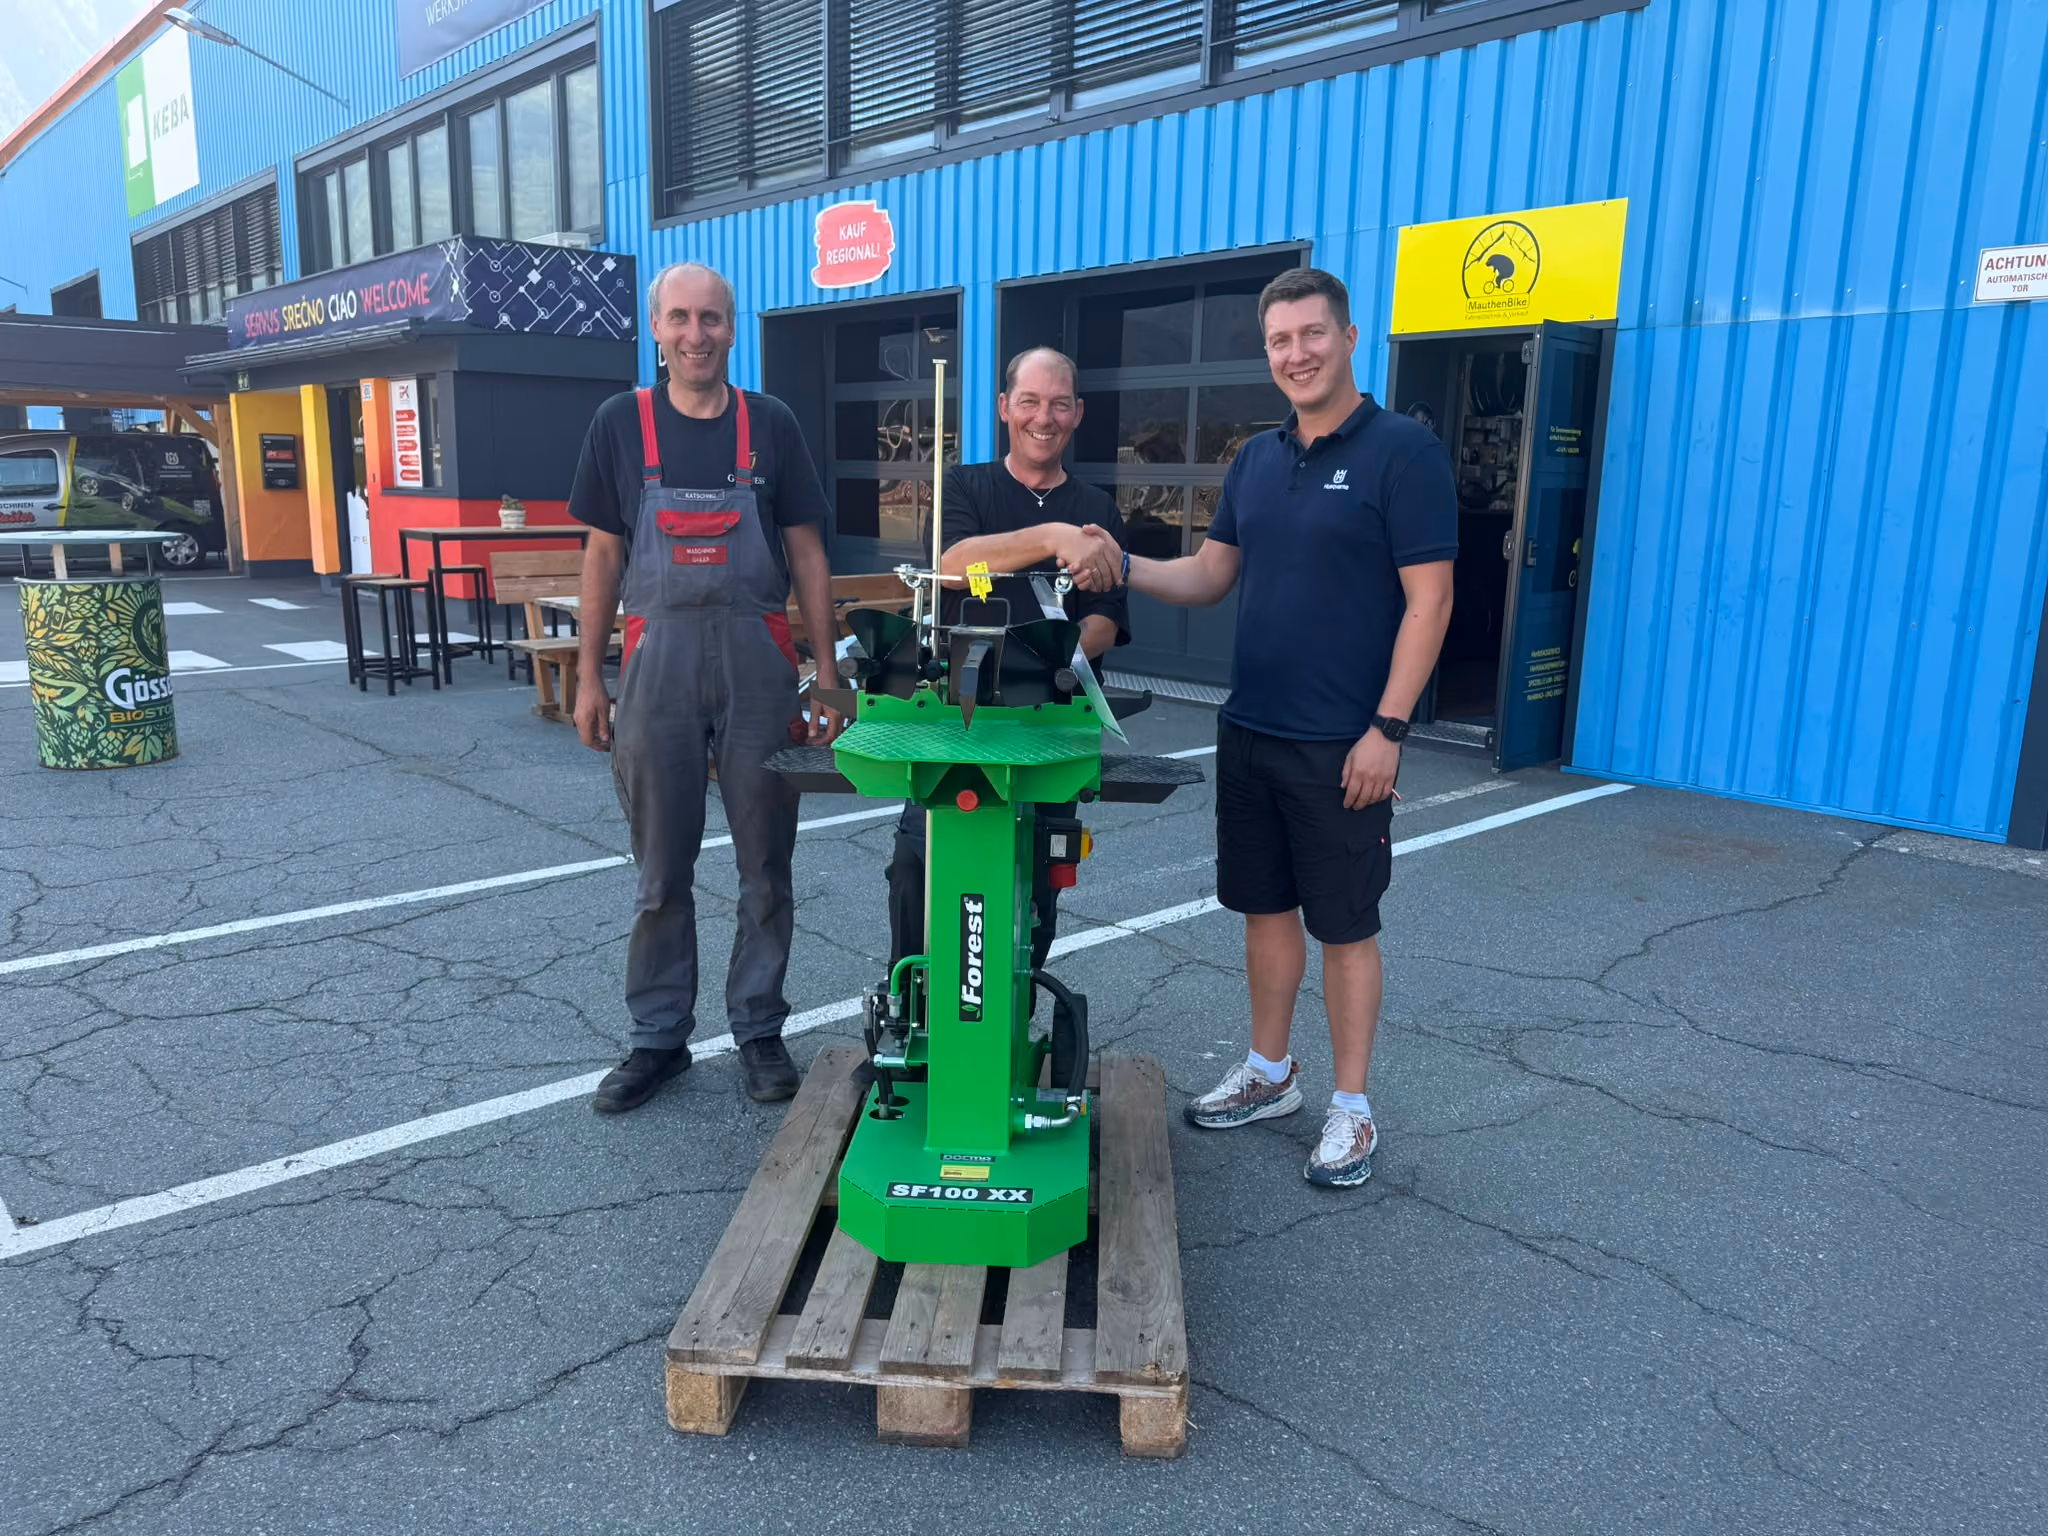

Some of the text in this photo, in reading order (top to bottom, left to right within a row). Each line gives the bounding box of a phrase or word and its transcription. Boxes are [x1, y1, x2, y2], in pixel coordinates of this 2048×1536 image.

[425, 0, 473, 26] WERKS
[153, 93, 189, 141] KEBA
[839, 221, 867, 241] KAUF
[826, 242, 880, 265] REGIONAL!
[1985, 254, 2048, 271] ACHTUN
[2012, 284, 2029, 293] TOR
[244, 273, 430, 338] SERVUS SREČNO CIAO WELCOME
[1468, 297, 1527, 310] MauthenBike
[961, 899, 983, 1005] Forest
[892, 1184, 1028, 1202] SF100 XX
